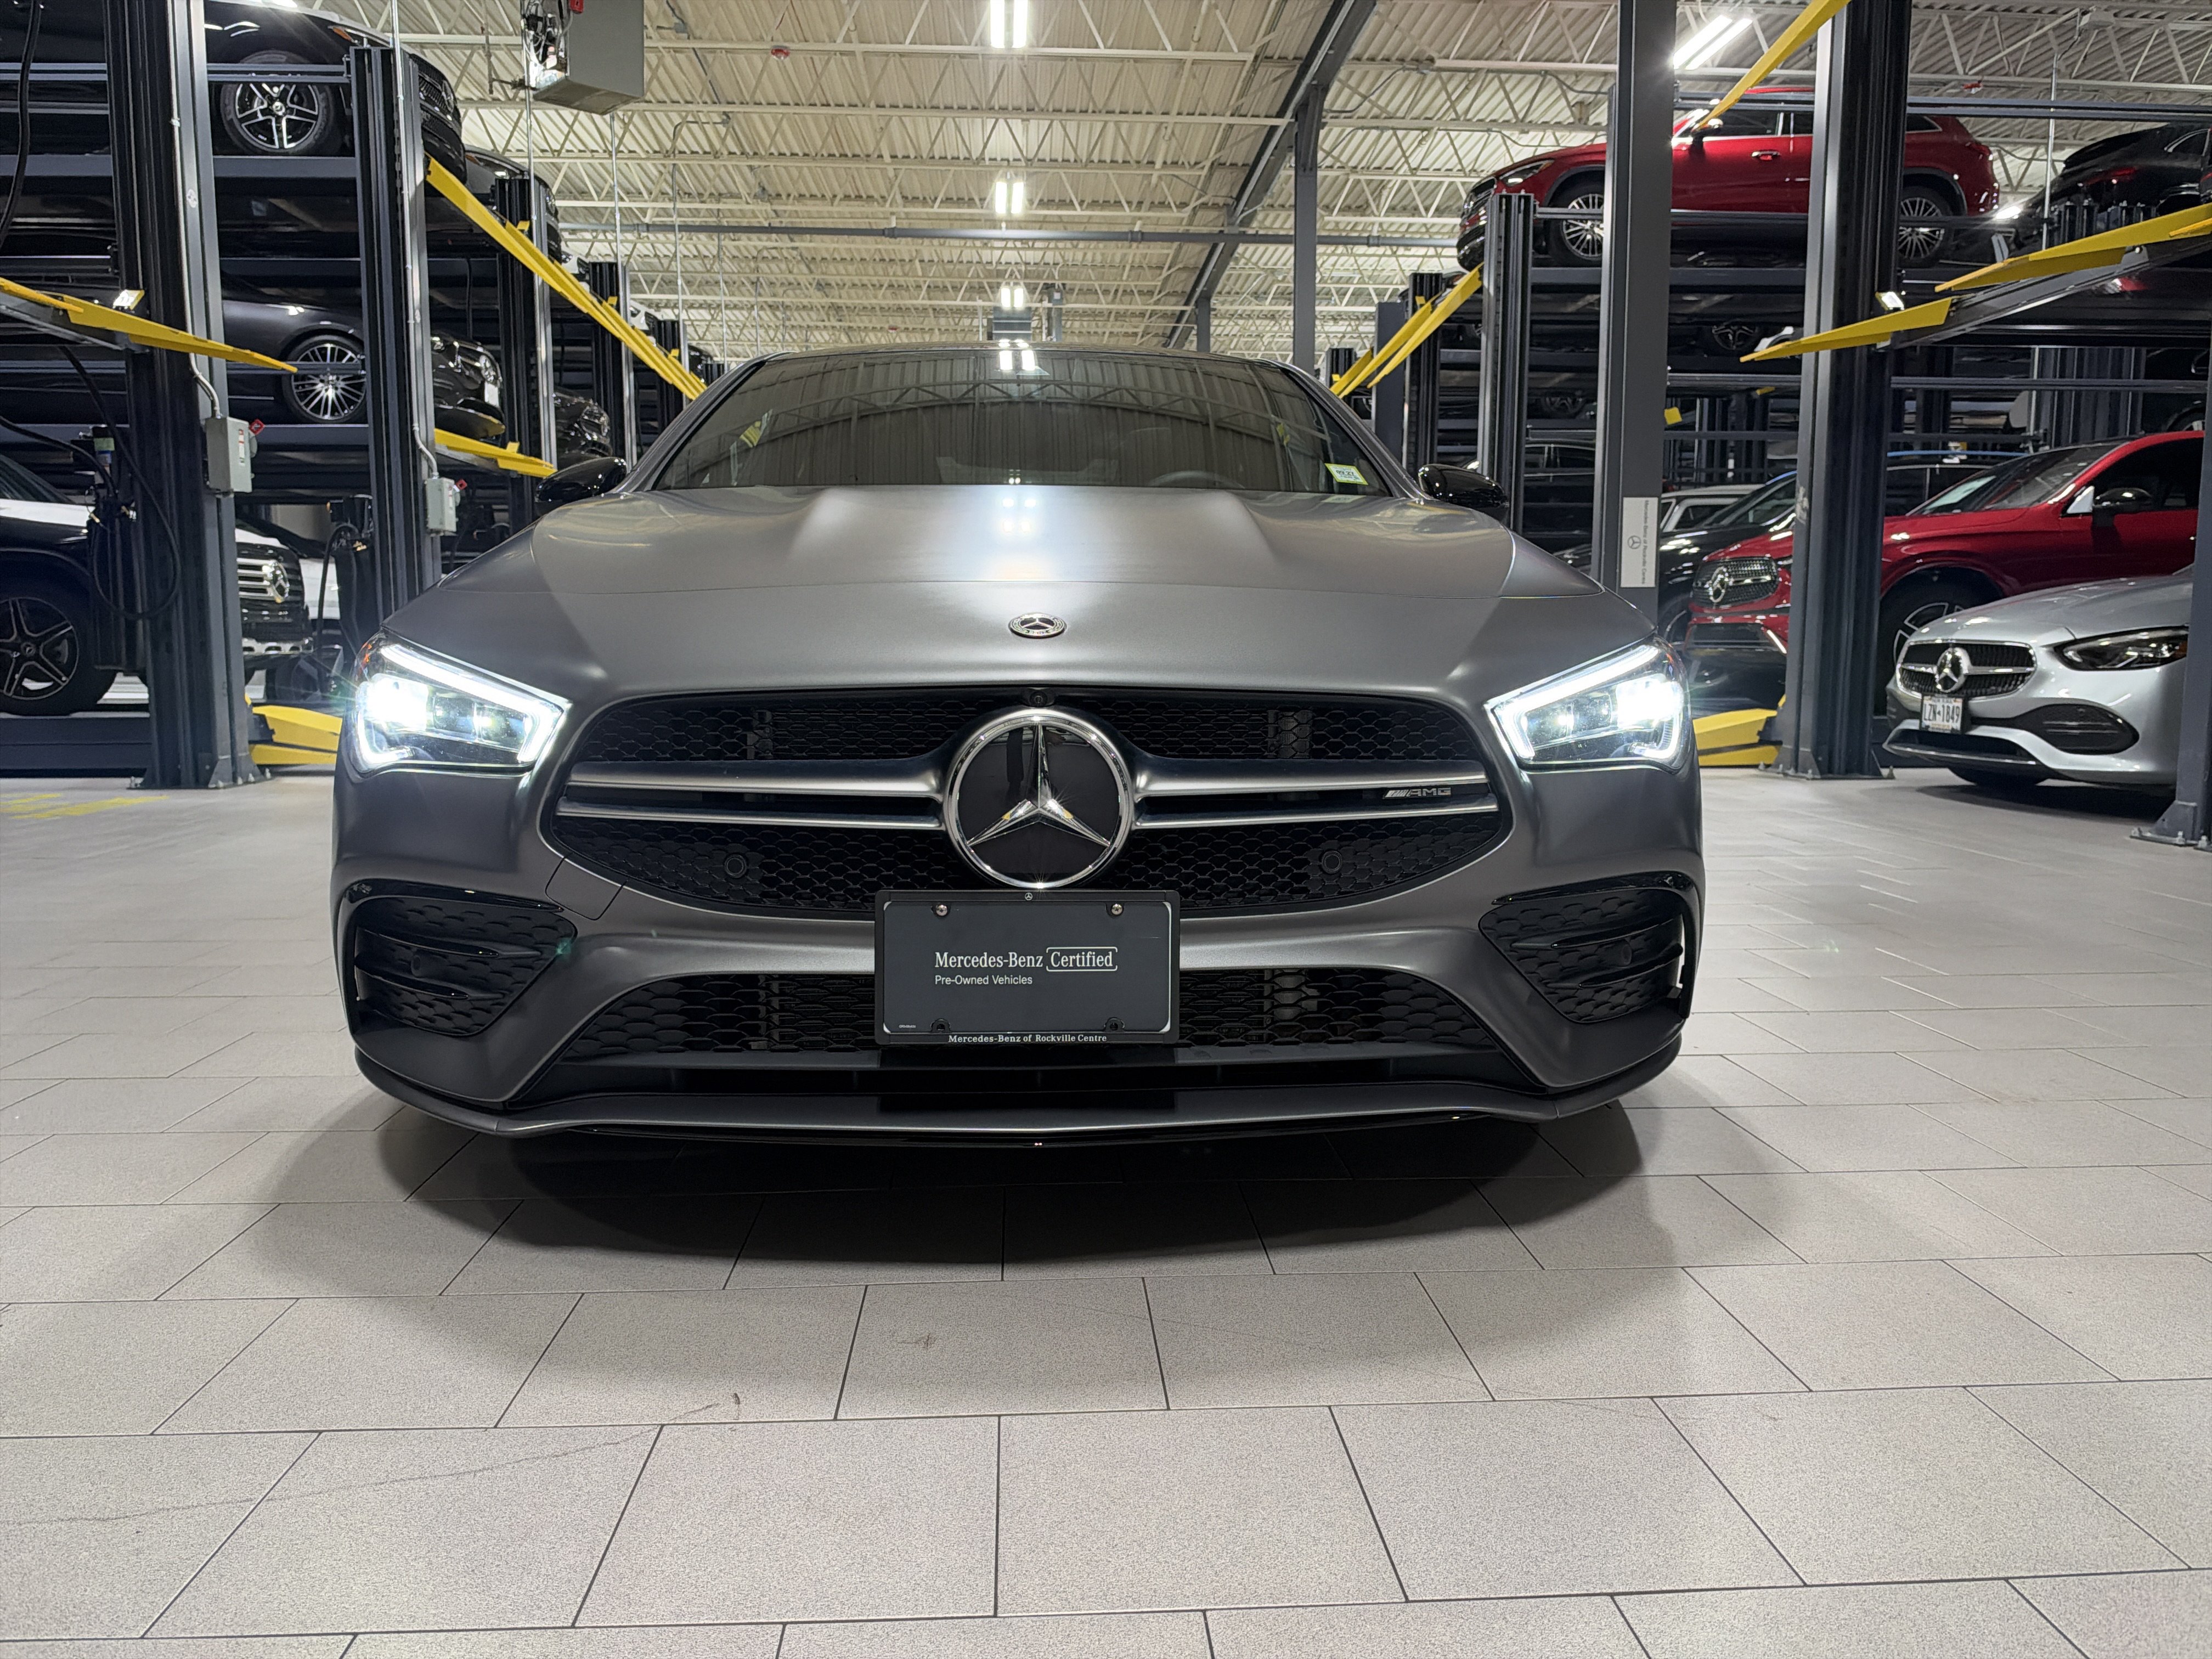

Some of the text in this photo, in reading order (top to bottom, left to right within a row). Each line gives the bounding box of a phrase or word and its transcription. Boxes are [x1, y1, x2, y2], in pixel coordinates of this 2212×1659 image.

[1406, 787, 1451, 797] AMG
[935, 951, 1113, 967] Mercedes-Benz Certified
[935, 975, 1032, 985] Pre-Owned Vehicles
